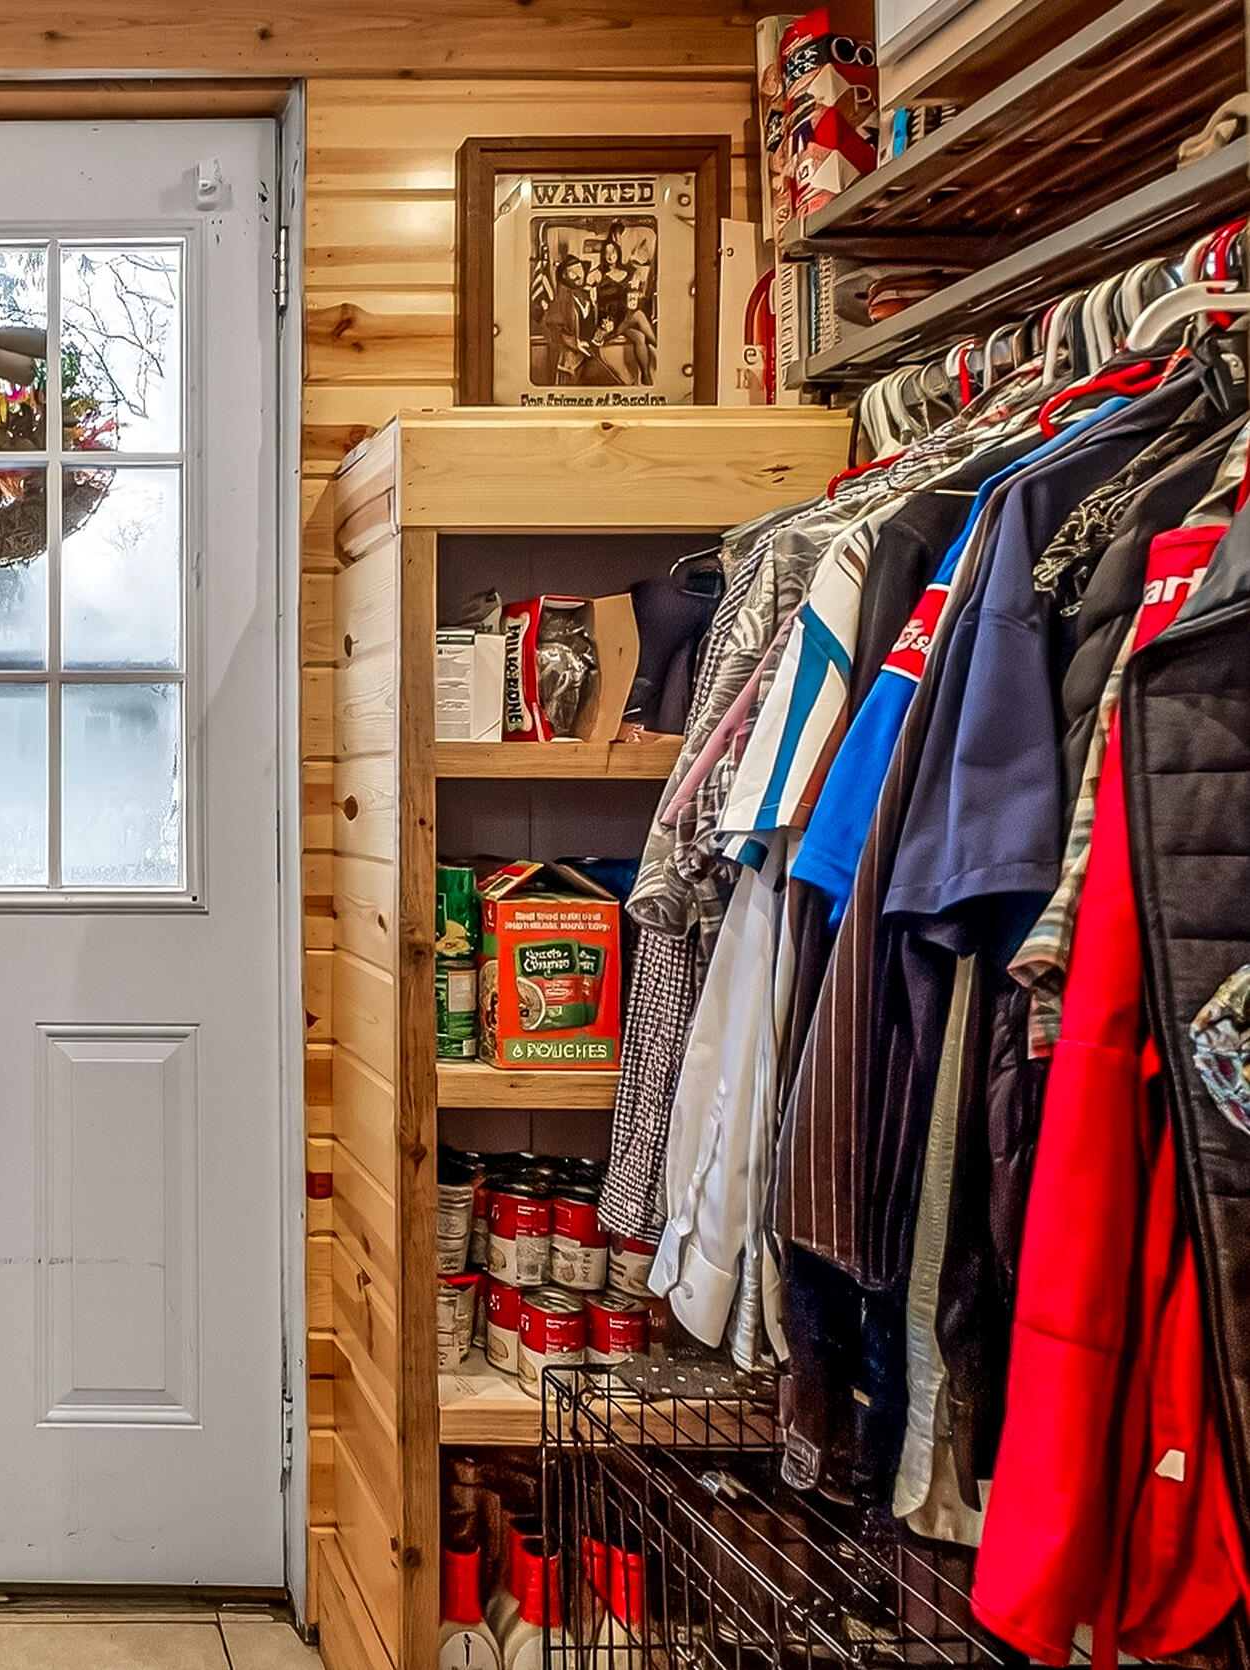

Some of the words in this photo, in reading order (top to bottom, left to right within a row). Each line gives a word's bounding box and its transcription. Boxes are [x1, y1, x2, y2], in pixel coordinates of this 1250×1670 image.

[533, 182, 654, 204] WANTED
[512, 1044, 523, 1058] 6
[527, 1043, 608, 1058] POUCHES
